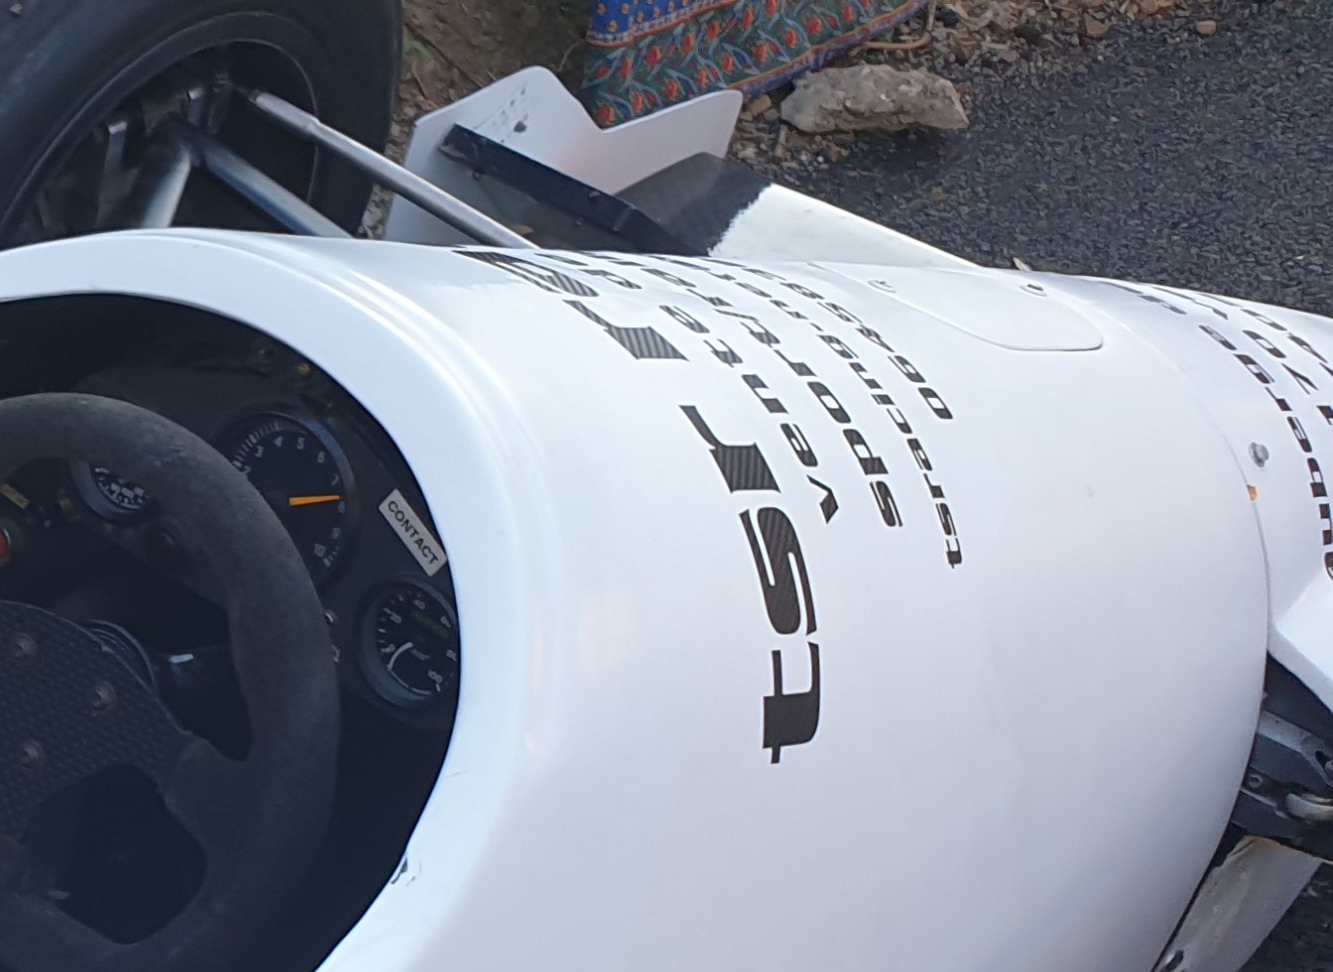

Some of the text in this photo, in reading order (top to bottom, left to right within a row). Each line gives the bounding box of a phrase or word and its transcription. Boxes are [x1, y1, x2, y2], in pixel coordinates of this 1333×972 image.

[451, 249, 821, 764] tsr ra
[659, 304, 840, 524] vente
[386, 499, 439, 566] CONTACT
